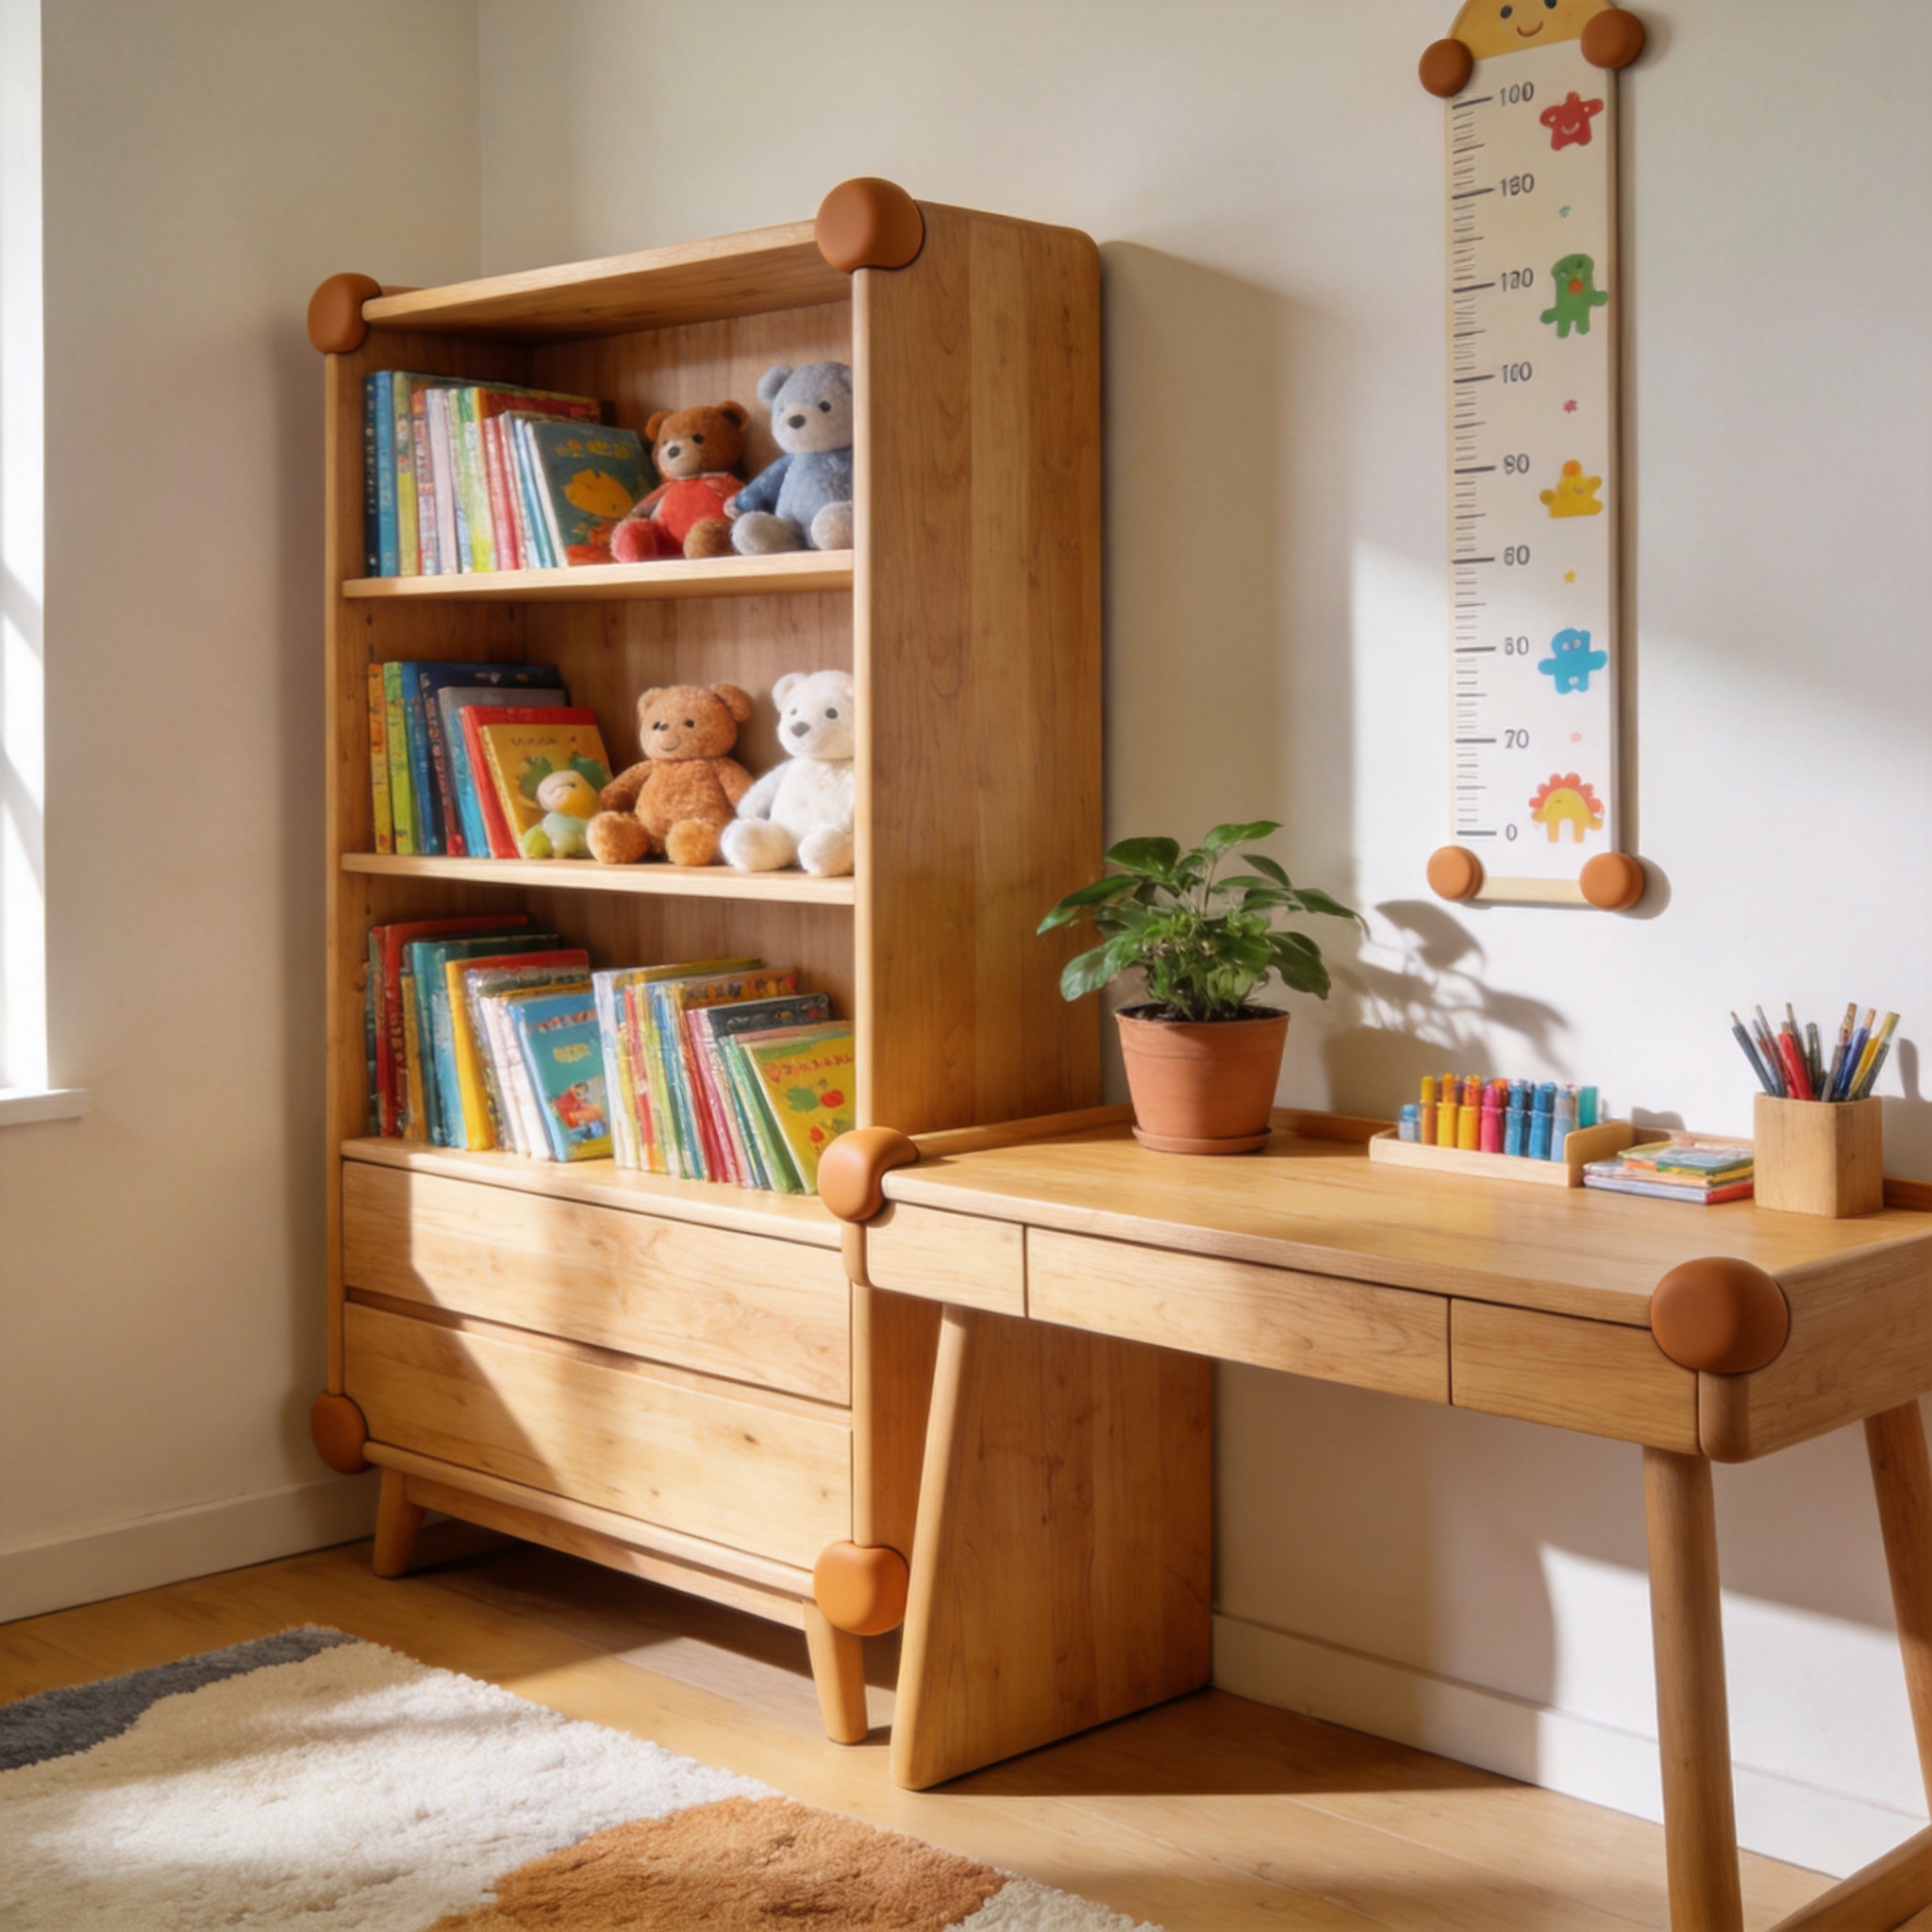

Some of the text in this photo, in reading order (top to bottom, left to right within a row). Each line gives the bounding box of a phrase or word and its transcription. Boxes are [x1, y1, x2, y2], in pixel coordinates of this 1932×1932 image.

[1499, 81, 1535, 107] 100
[1504, 728, 1530, 750] 70
[1505, 823, 1519, 842] 0
